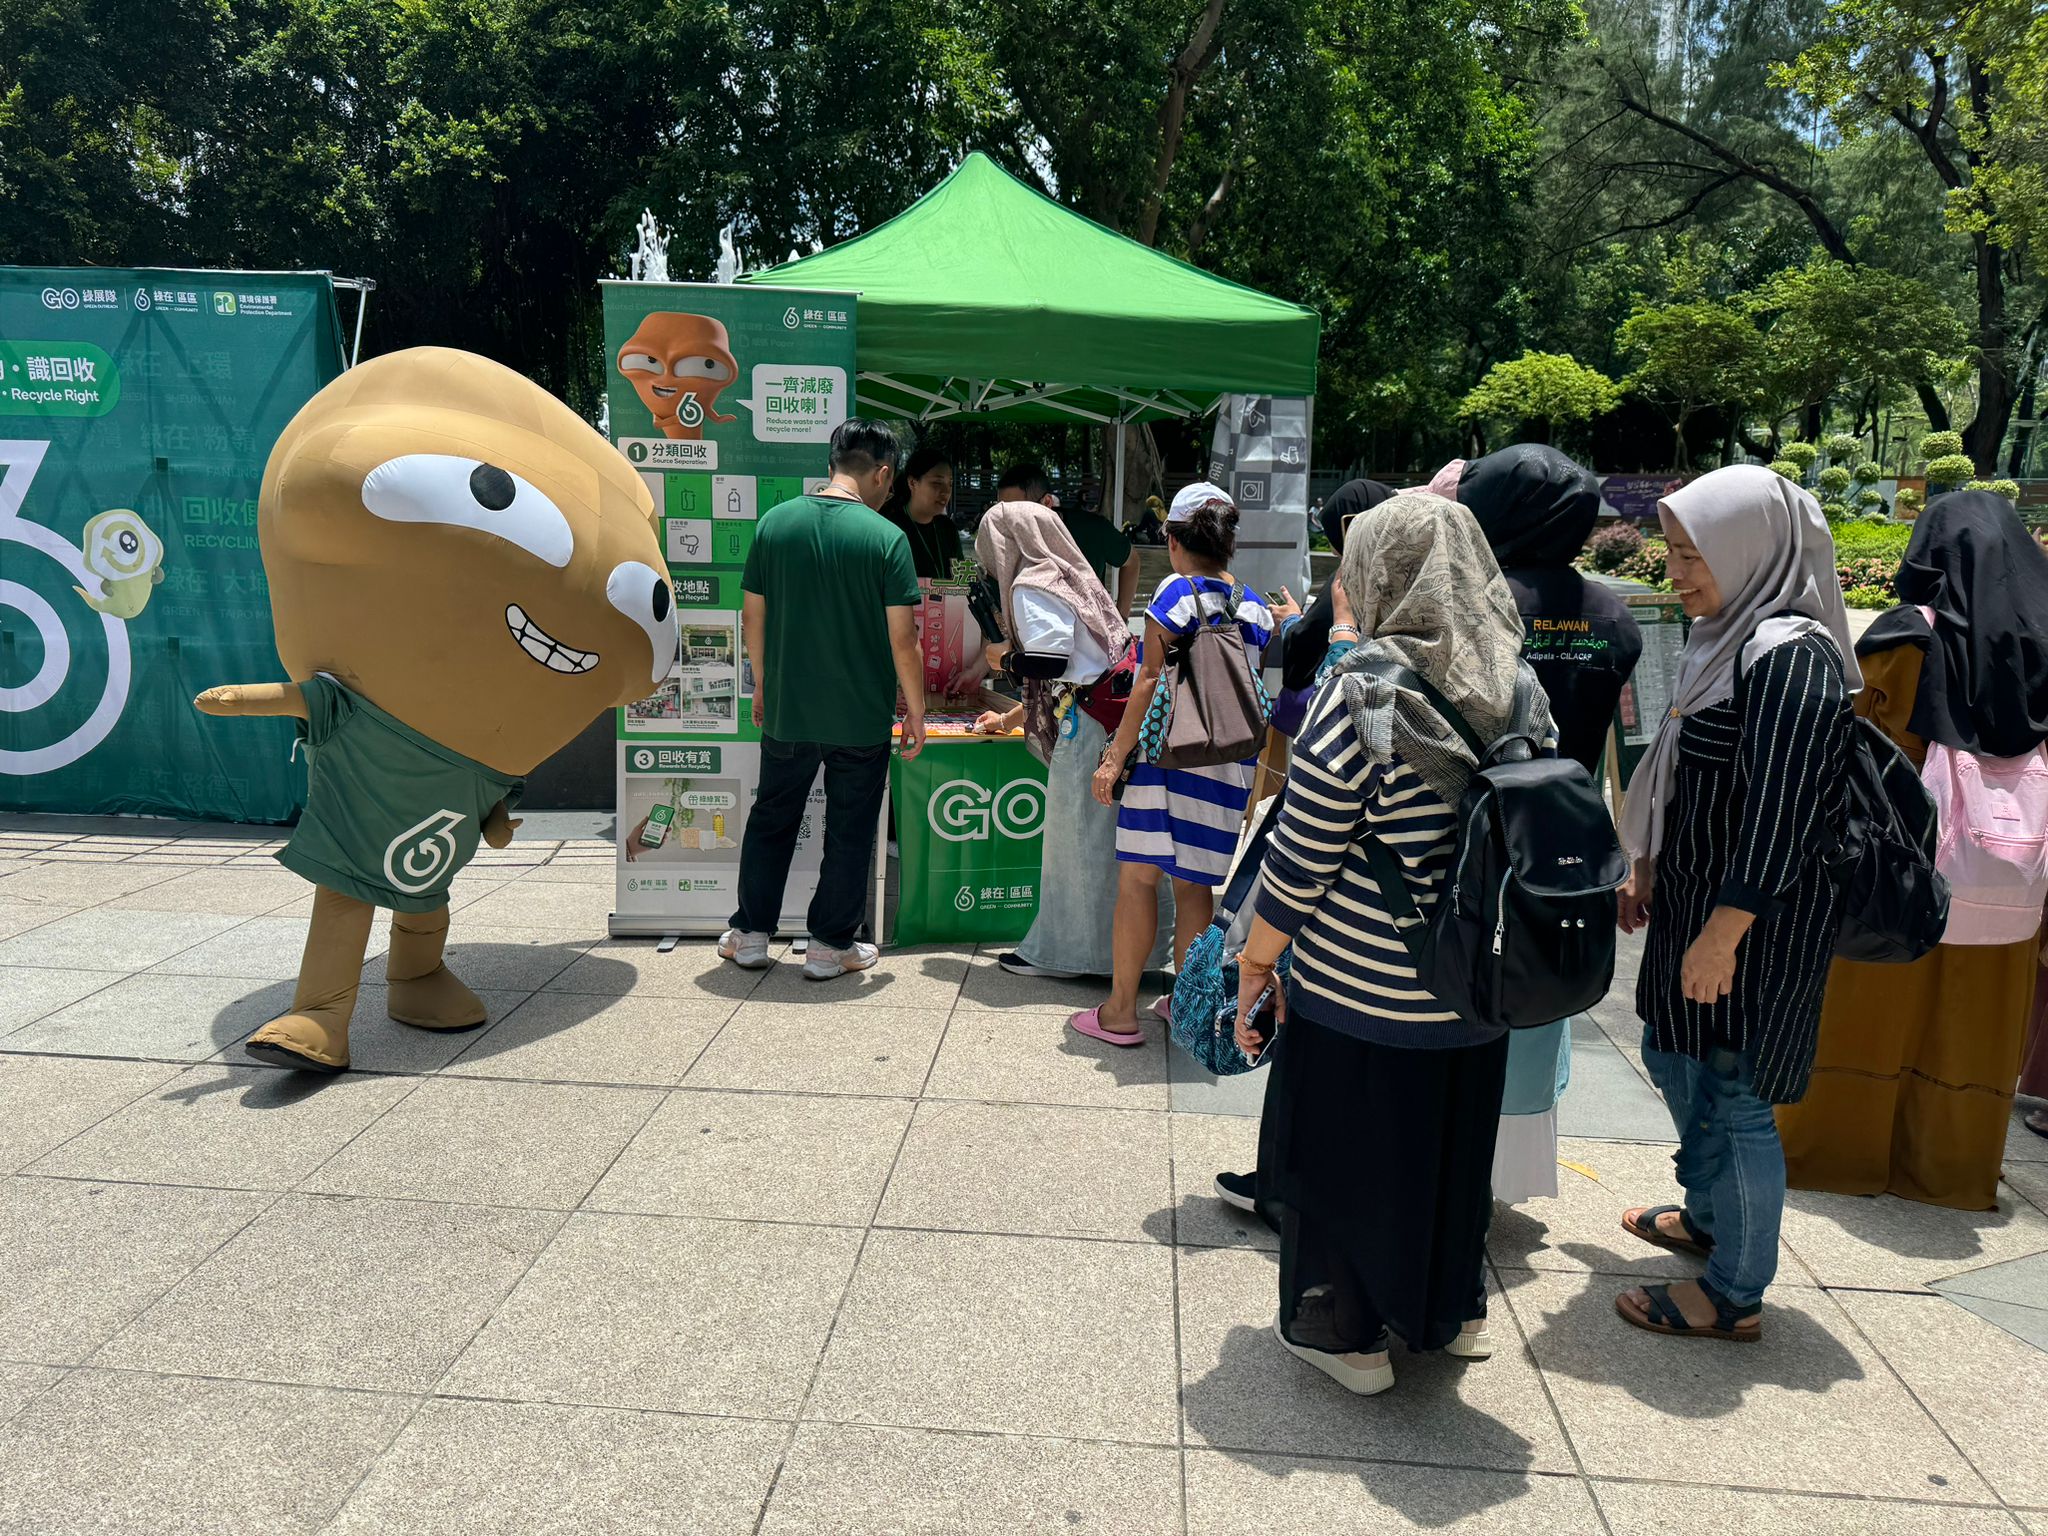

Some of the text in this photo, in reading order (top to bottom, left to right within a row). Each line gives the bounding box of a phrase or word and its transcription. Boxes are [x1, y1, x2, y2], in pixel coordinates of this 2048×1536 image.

[26, 356, 97, 383] 識回收
[765, 376, 834, 395] 一齊減廢
[11, 387, 100, 405] Recycle Right
[766, 417, 792, 425] Reduce
[766, 426, 791, 434] recycle
[652, 443, 707, 458] 分類回收
[674, 458, 708, 466] Separation
[685, 594, 710, 602] Recycle
[1533, 619, 1589, 632] RELAWAN
[639, 753, 650, 766] 3
[658, 750, 712, 764] 回收有賞
[927, 777, 1048, 842] GO
[980, 885, 1033, 900] 綠在 區區
